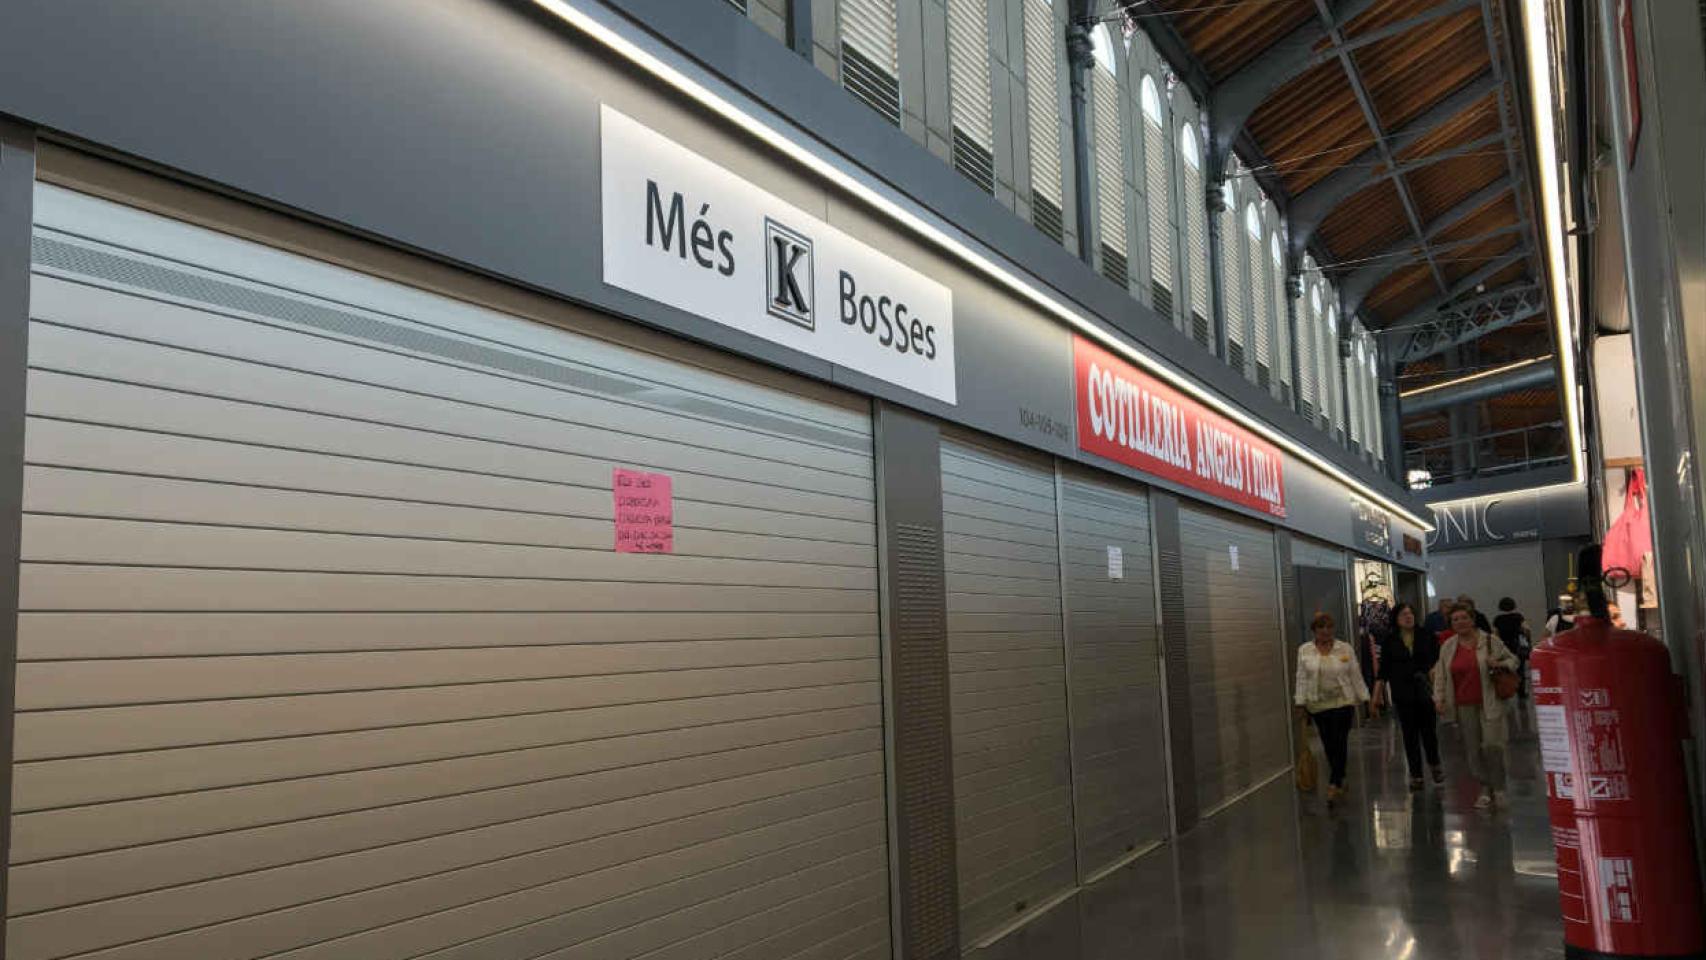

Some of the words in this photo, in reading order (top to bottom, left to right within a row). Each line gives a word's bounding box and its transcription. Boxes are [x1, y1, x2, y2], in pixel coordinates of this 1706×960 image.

[646, 179, 736, 277] Més
[773, 235, 810, 313] K
[839, 269, 937, 361] BoSSes
[1088, 362, 1192, 472] COTILLERIA
[1196, 419, 1243, 492] ANGELS
[1244, 442, 1252, 496] I
